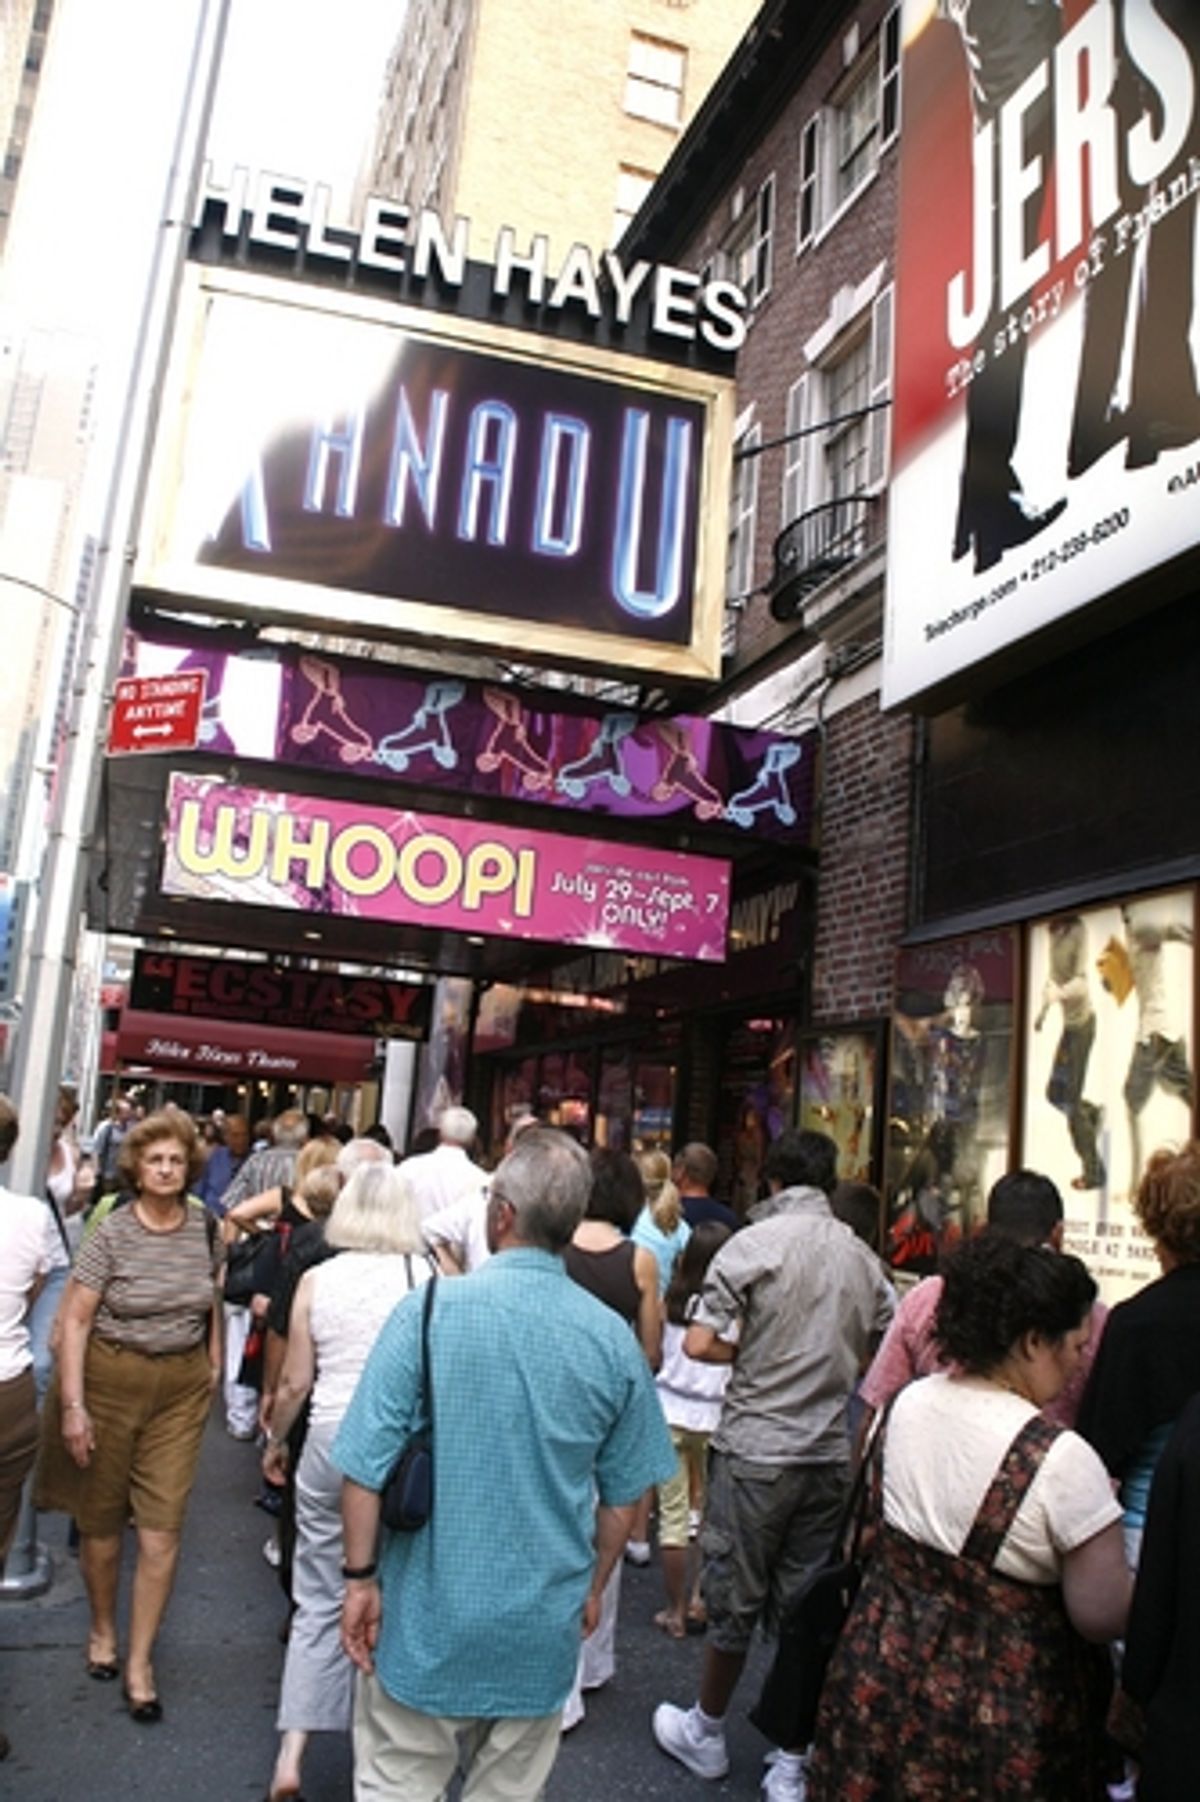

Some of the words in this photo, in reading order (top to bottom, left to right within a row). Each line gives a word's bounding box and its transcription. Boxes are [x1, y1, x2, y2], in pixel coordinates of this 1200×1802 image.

[193, 160, 472, 287] HELEN
[494, 226, 750, 352] HAYES
[945, 350, 985, 399] The
[994, 279, 1064, 358] story
[1074, 236, 1106, 288] of
[119, 683, 137, 700] NO
[140, 677, 199, 699] STANDING
[123, 699, 186, 720] ANYTIME
[176, 800, 535, 918] WHOOPI
[551, 872, 597, 903] July
[705, 893, 720, 913] 7
